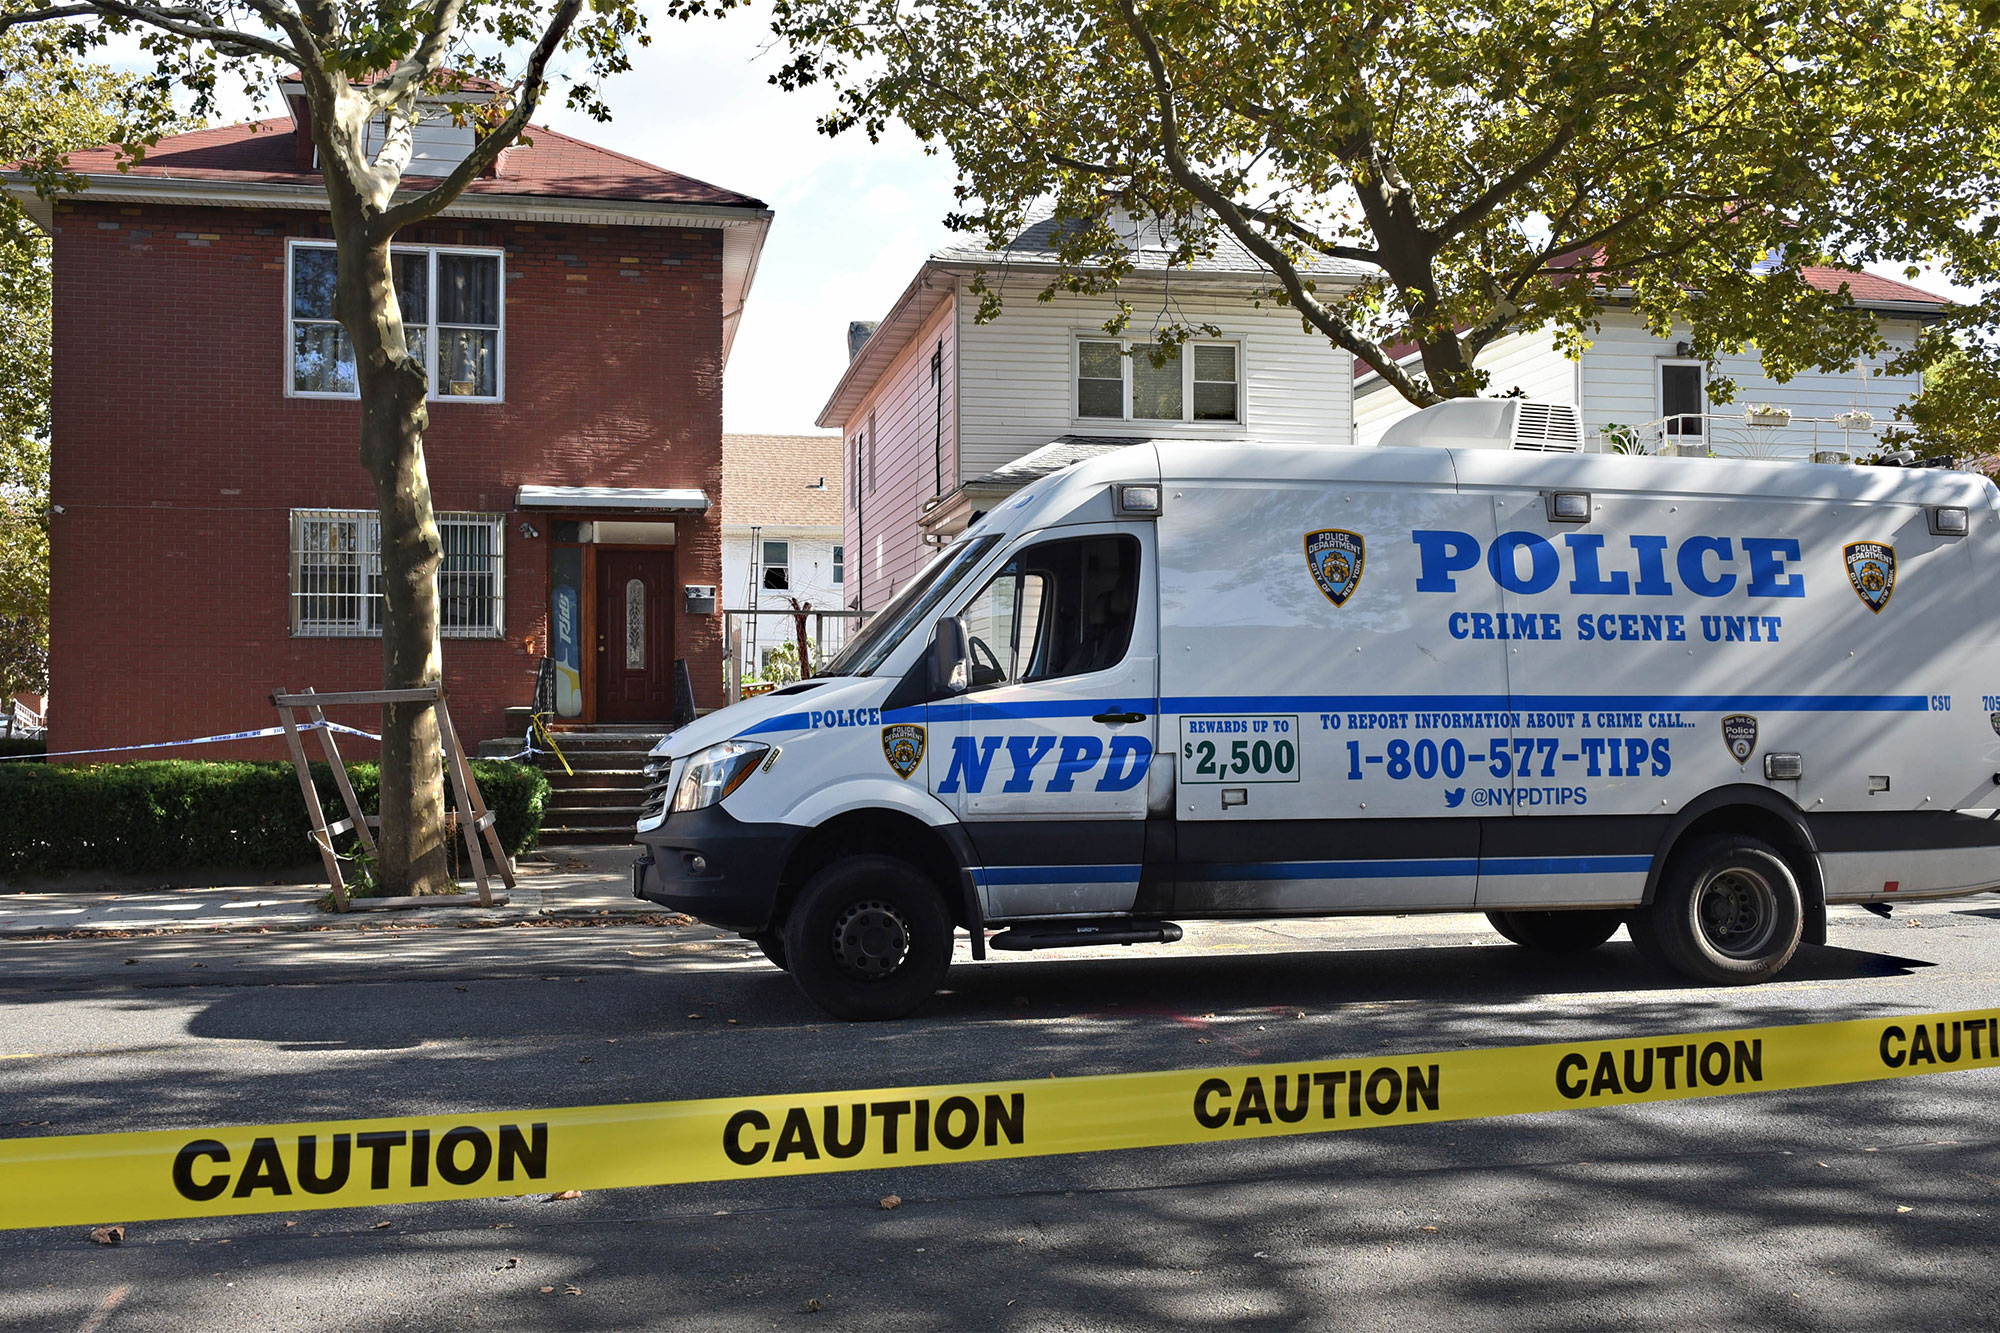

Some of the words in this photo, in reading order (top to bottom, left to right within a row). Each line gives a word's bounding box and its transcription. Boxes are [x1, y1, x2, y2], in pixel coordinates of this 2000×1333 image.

[1308, 540, 1361, 554] DEPARTMENT
[1319, 532, 1350, 542] POLICE
[1855, 544, 1882, 553] POLICE
[1412, 529, 1806, 598] POLICE
[1847, 552, 1893, 565] DEPARTMENT
[1311, 562, 1323, 581] CITY
[1321, 583, 1331, 593] OF
[1342, 581, 1355, 597] NEW
[1352, 559, 1362, 579] YORK
[1850, 572, 1862, 589] CITY
[1860, 591, 1870, 601] OF
[1886, 569, 1895, 587] YORK
[1449, 612, 1562, 641] CRIME
[1578, 614, 1686, 642] SCENE
[1701, 616, 1782, 643] UNIT
[812, 708, 878, 729] POLICE
[1931, 695, 1951, 711] CSU
[1189, 721, 1248, 734] REWARDS
[1253, 720, 1269, 733] UP
[1273, 720, 1290, 733] TO
[1320, 714, 1341, 729] TO
[1348, 714, 1408, 729] REPORT
[1415, 713, 1520, 729] INFORMATION
[1527, 713, 1574, 728] ABOUT
[1581, 713, 1591, 728] A
[1597, 713, 1643, 728] CRIME
[1648, 713, 1696, 728] CALL...
[884, 732, 923, 743] DEPARTMENT
[937, 736, 1153, 793] NYPD
[1184, 740, 1295, 780] $2,500
[1346, 738, 1671, 780] 1-800-577-TIPS
[1471, 787, 1588, 808] @NYPDTIPS
[1880, 1018, 2000, 1068] CAUTI
[1556, 1039, 1762, 1099] CAUTION
[1194, 1065, 1439, 1129] CAUTION
[723, 1093, 1024, 1165] CAUTION
[173, 1123, 547, 1202] CAUTION
